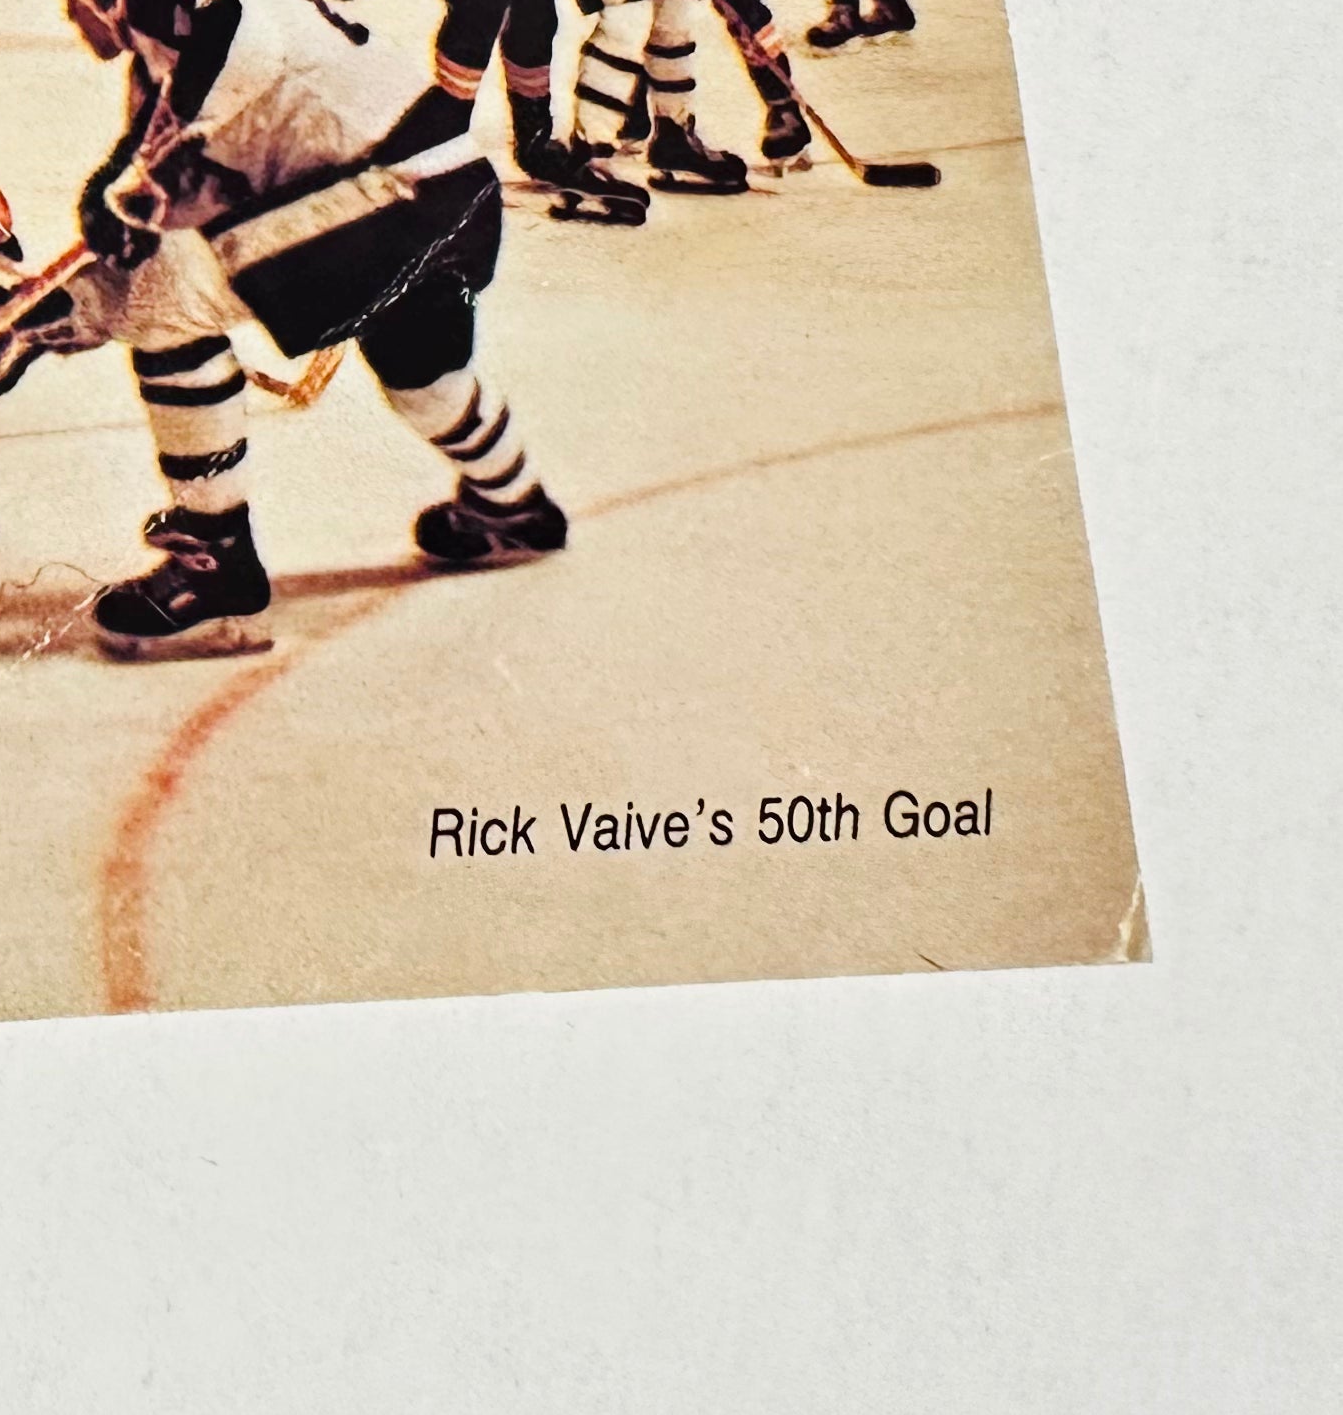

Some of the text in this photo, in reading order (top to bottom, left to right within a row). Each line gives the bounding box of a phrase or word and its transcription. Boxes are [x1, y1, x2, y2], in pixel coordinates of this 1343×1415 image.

[429, 787, 994, 859] Rick Vaive's 50th Goal
